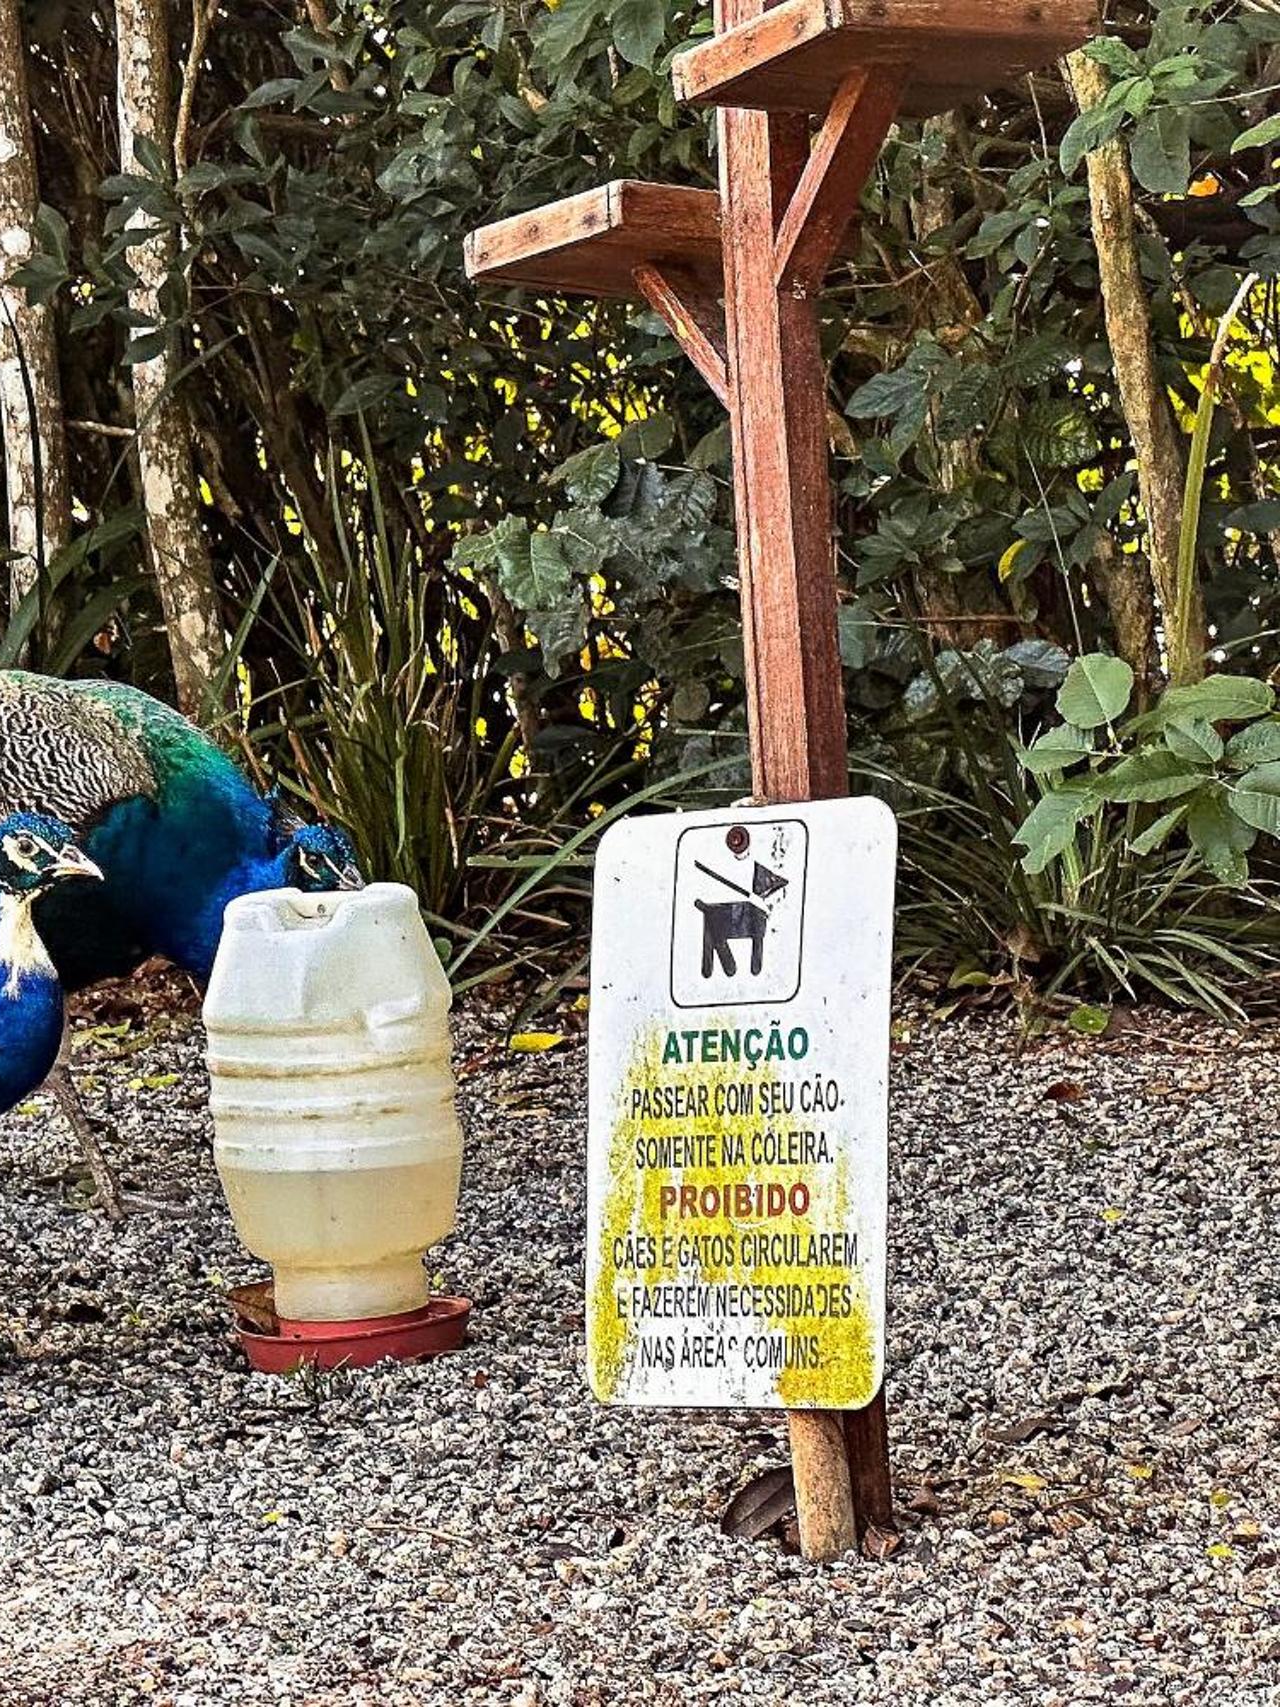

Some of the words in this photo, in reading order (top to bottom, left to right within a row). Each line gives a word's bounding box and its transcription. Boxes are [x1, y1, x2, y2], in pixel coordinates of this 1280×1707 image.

[662, 1020, 810, 1070] ATENÇÃO
[631, 1084, 709, 1120] PASSEAR
[714, 1080, 754, 1116] COM
[759, 1081, 794, 1114] SEU
[635, 1133, 717, 1169] SOMENTE
[721, 1132, 746, 1166] NA
[751, 1131, 834, 1165] COLEIRA.
[660, 1182, 810, 1219] PROIBIDO
[613, 1230, 656, 1269] CÃES
[662, 1235, 673, 1268] E
[678, 1234, 734, 1267] GATOS
[741, 1233, 858, 1267] CIRCULAREM
[617, 1286, 627, 1318] E
[632, 1286, 710, 1318] FAZEREM
[641, 1335, 675, 1370] NAS
